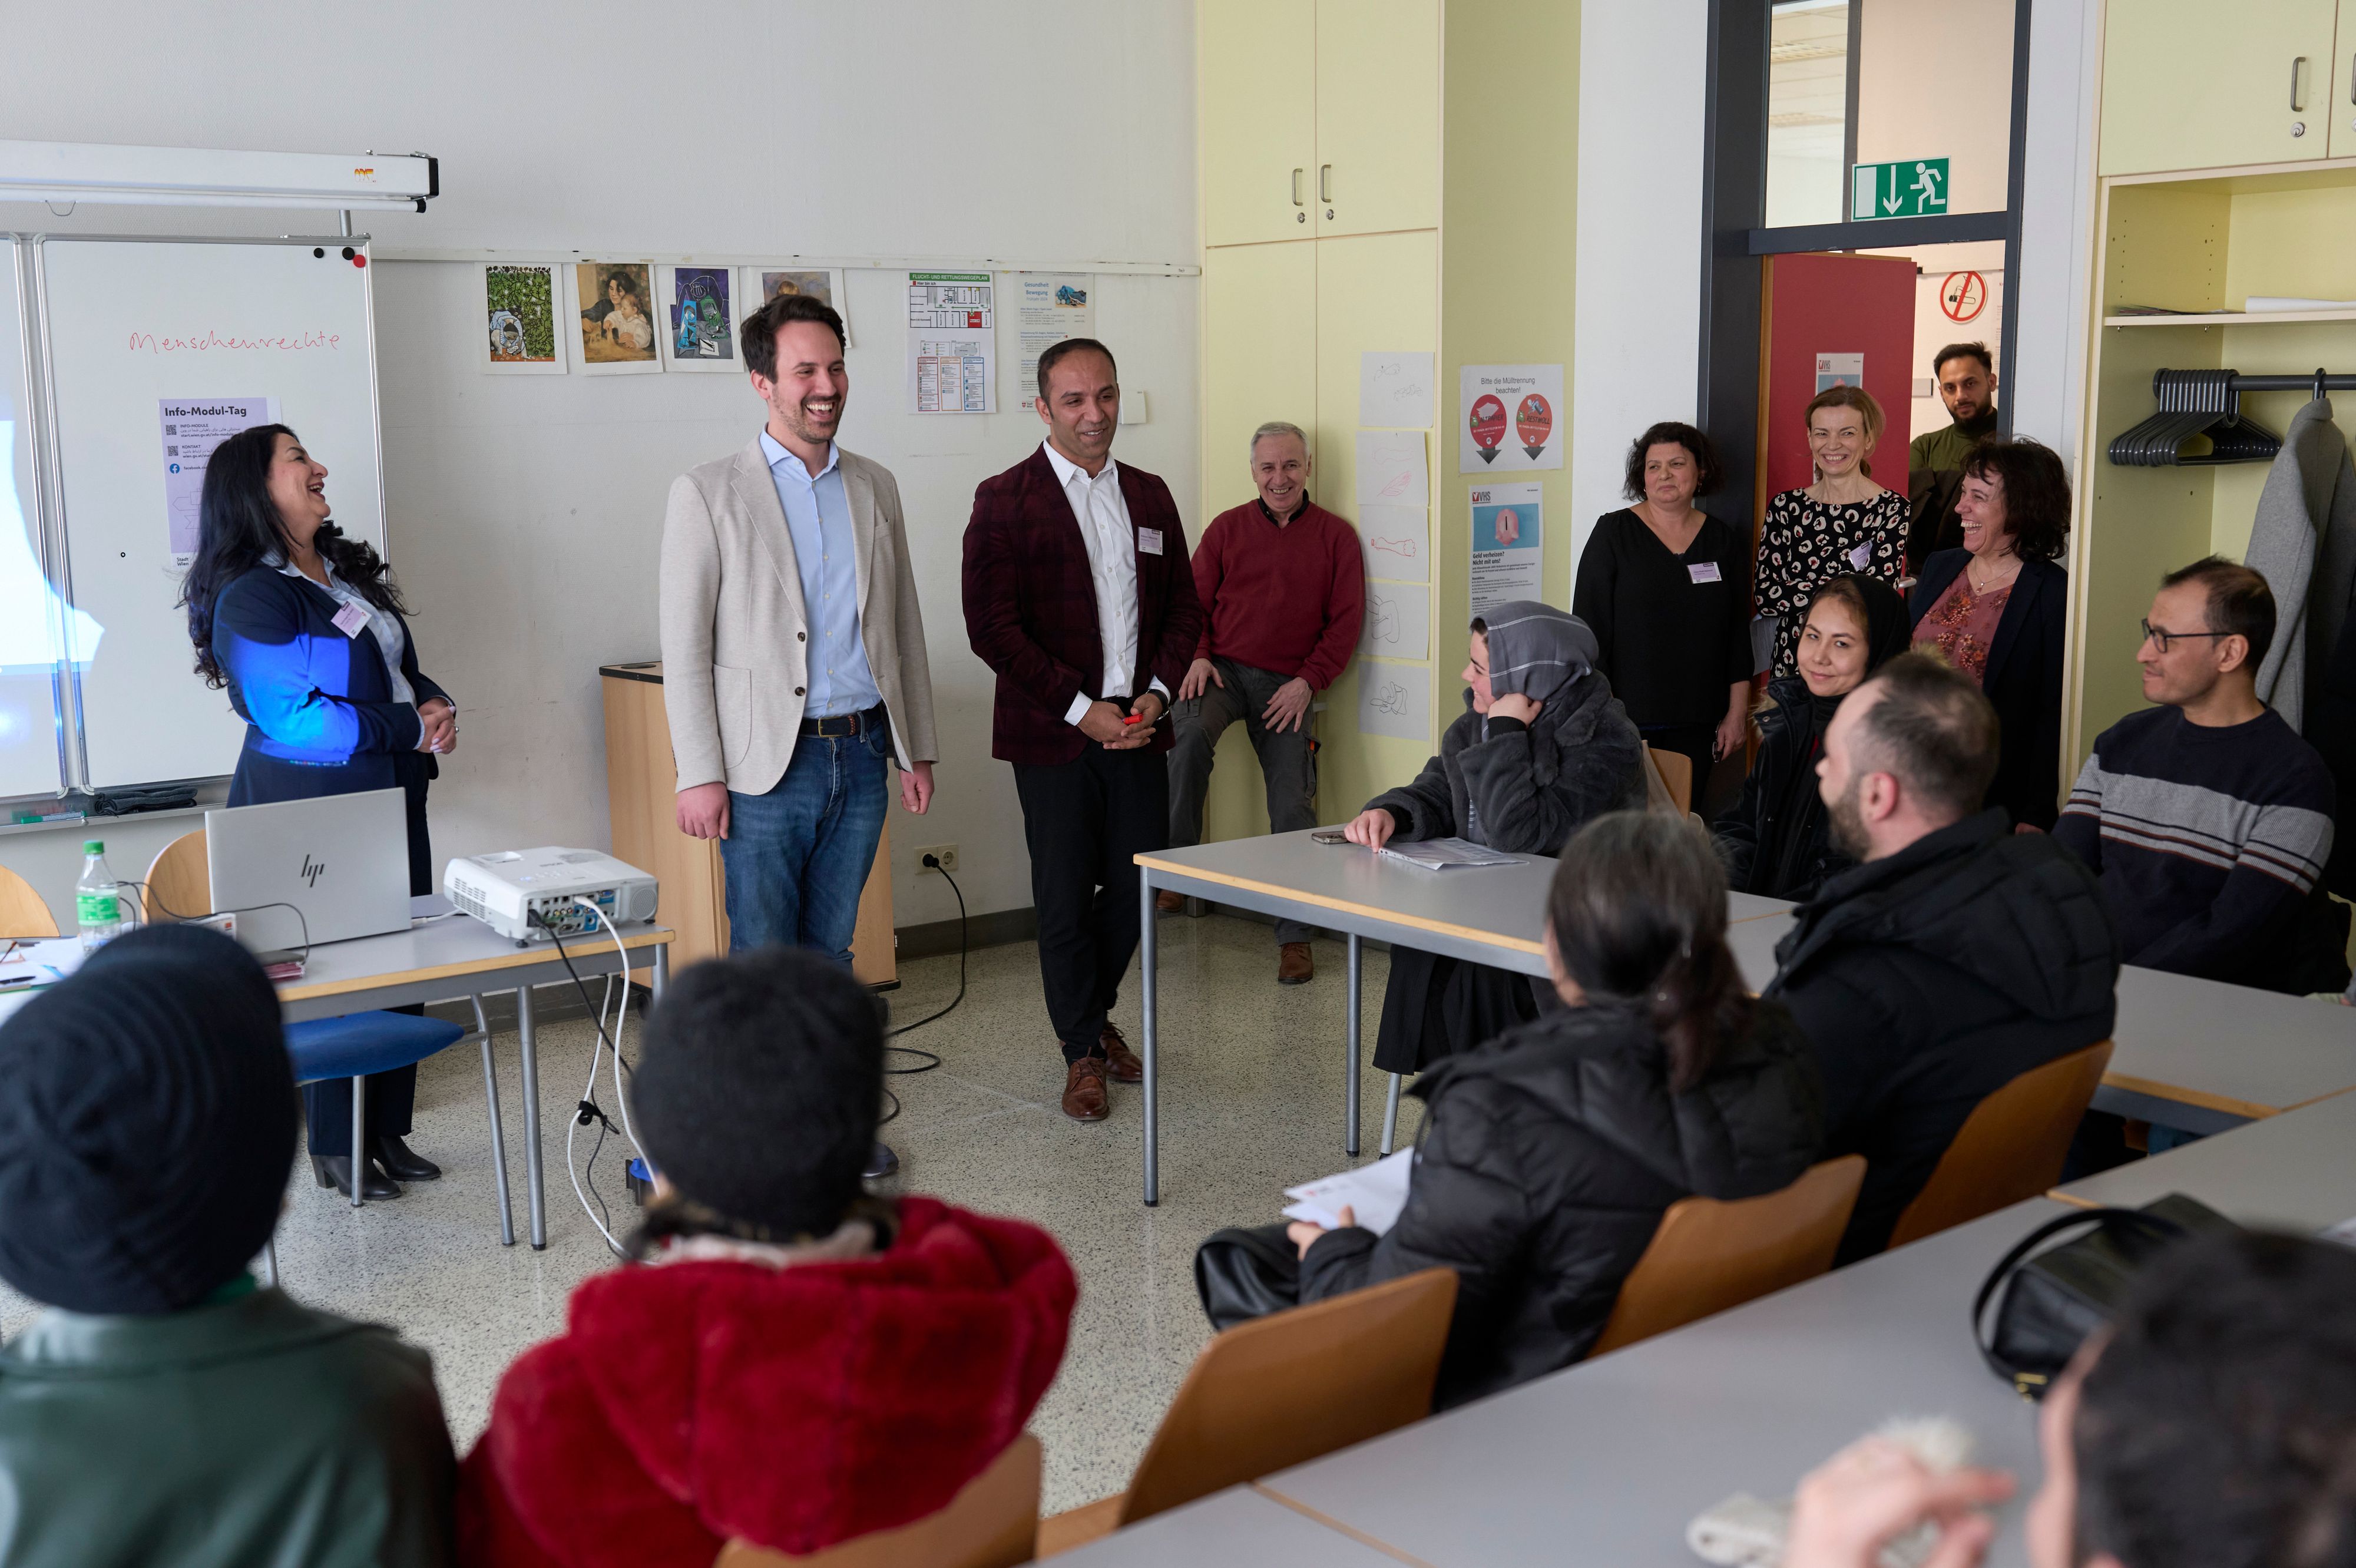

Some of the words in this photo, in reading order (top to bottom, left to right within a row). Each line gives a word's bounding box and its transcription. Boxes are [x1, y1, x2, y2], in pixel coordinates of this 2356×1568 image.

[130, 330, 339, 353] Menschenrechte
[165, 406, 247, 417] Info-Modul-Tag
[1479, 491, 1491, 501] VHS
[301, 854, 325, 888] hp
